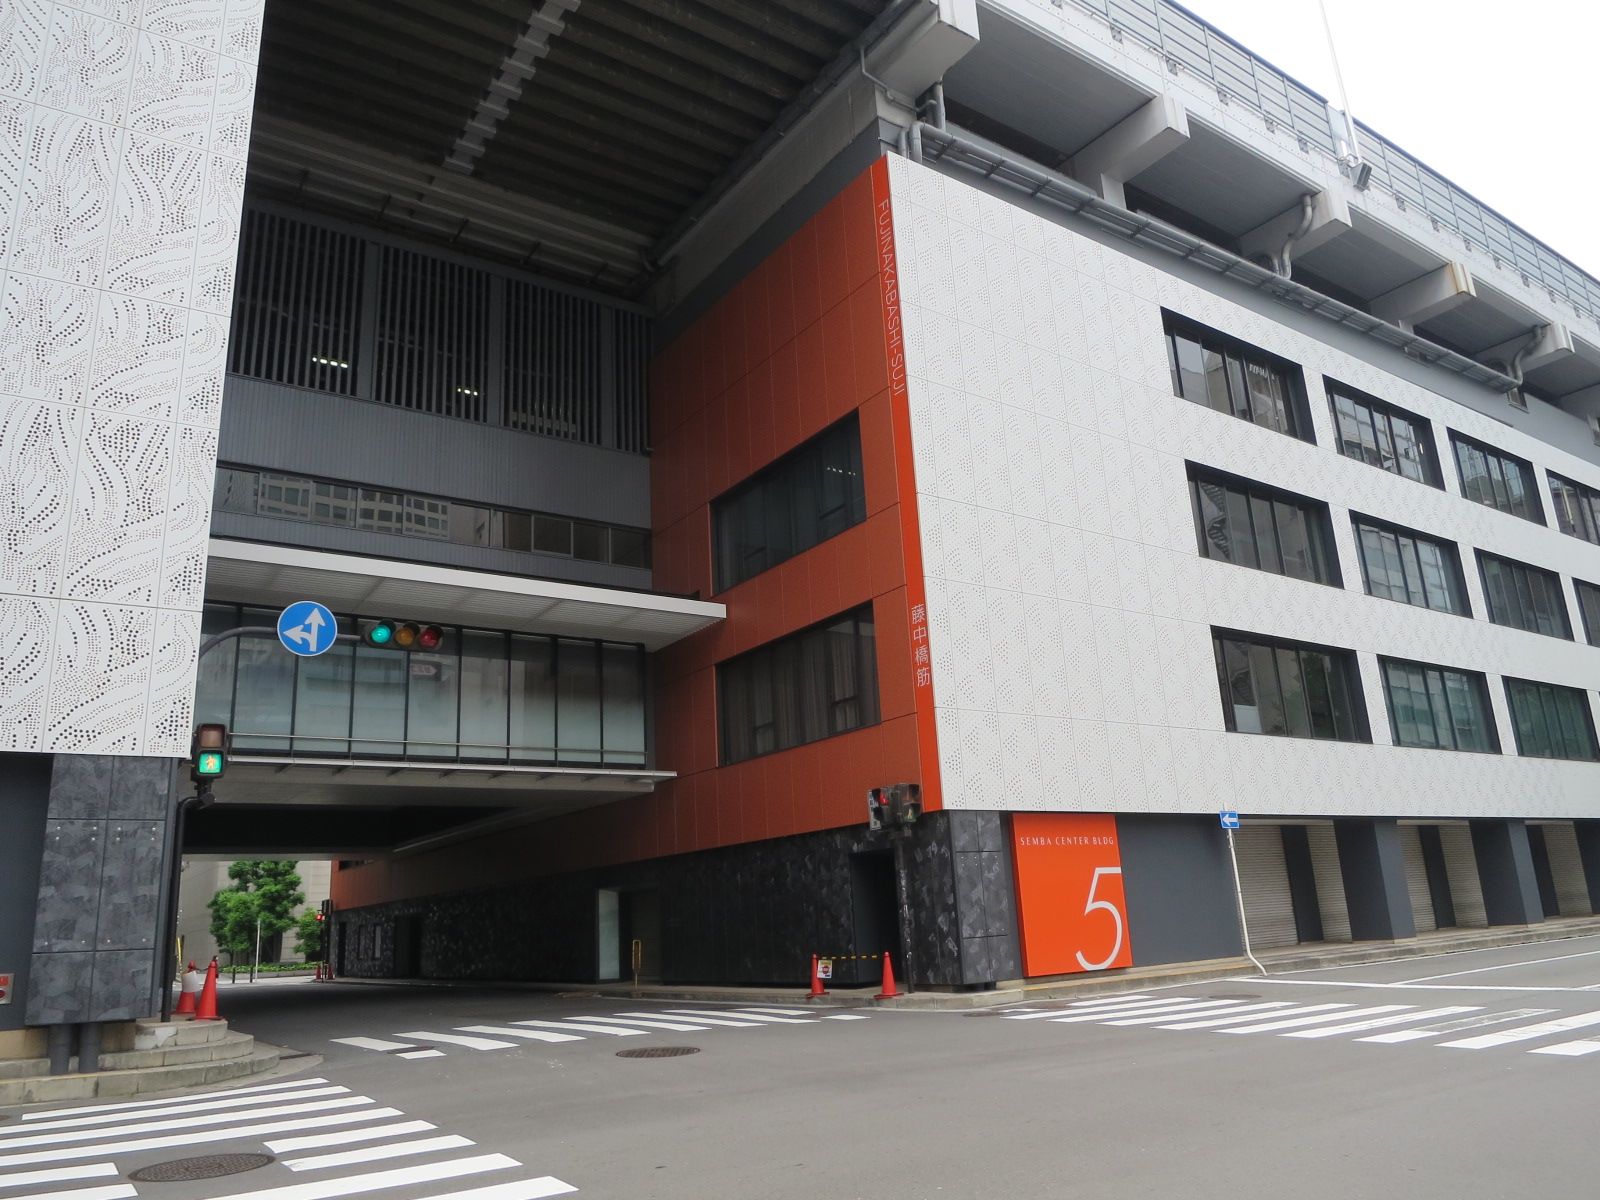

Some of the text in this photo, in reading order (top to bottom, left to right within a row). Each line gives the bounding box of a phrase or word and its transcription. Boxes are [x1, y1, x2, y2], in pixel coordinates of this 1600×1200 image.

[878, 198, 905, 395] FUJINAKABASHI-SUJI
[911, 603, 930, 687] 藤中橋筋
[1020, 836, 1114, 846] SEMBA CENTER BLDG
[1075, 866, 1123, 971] 5
